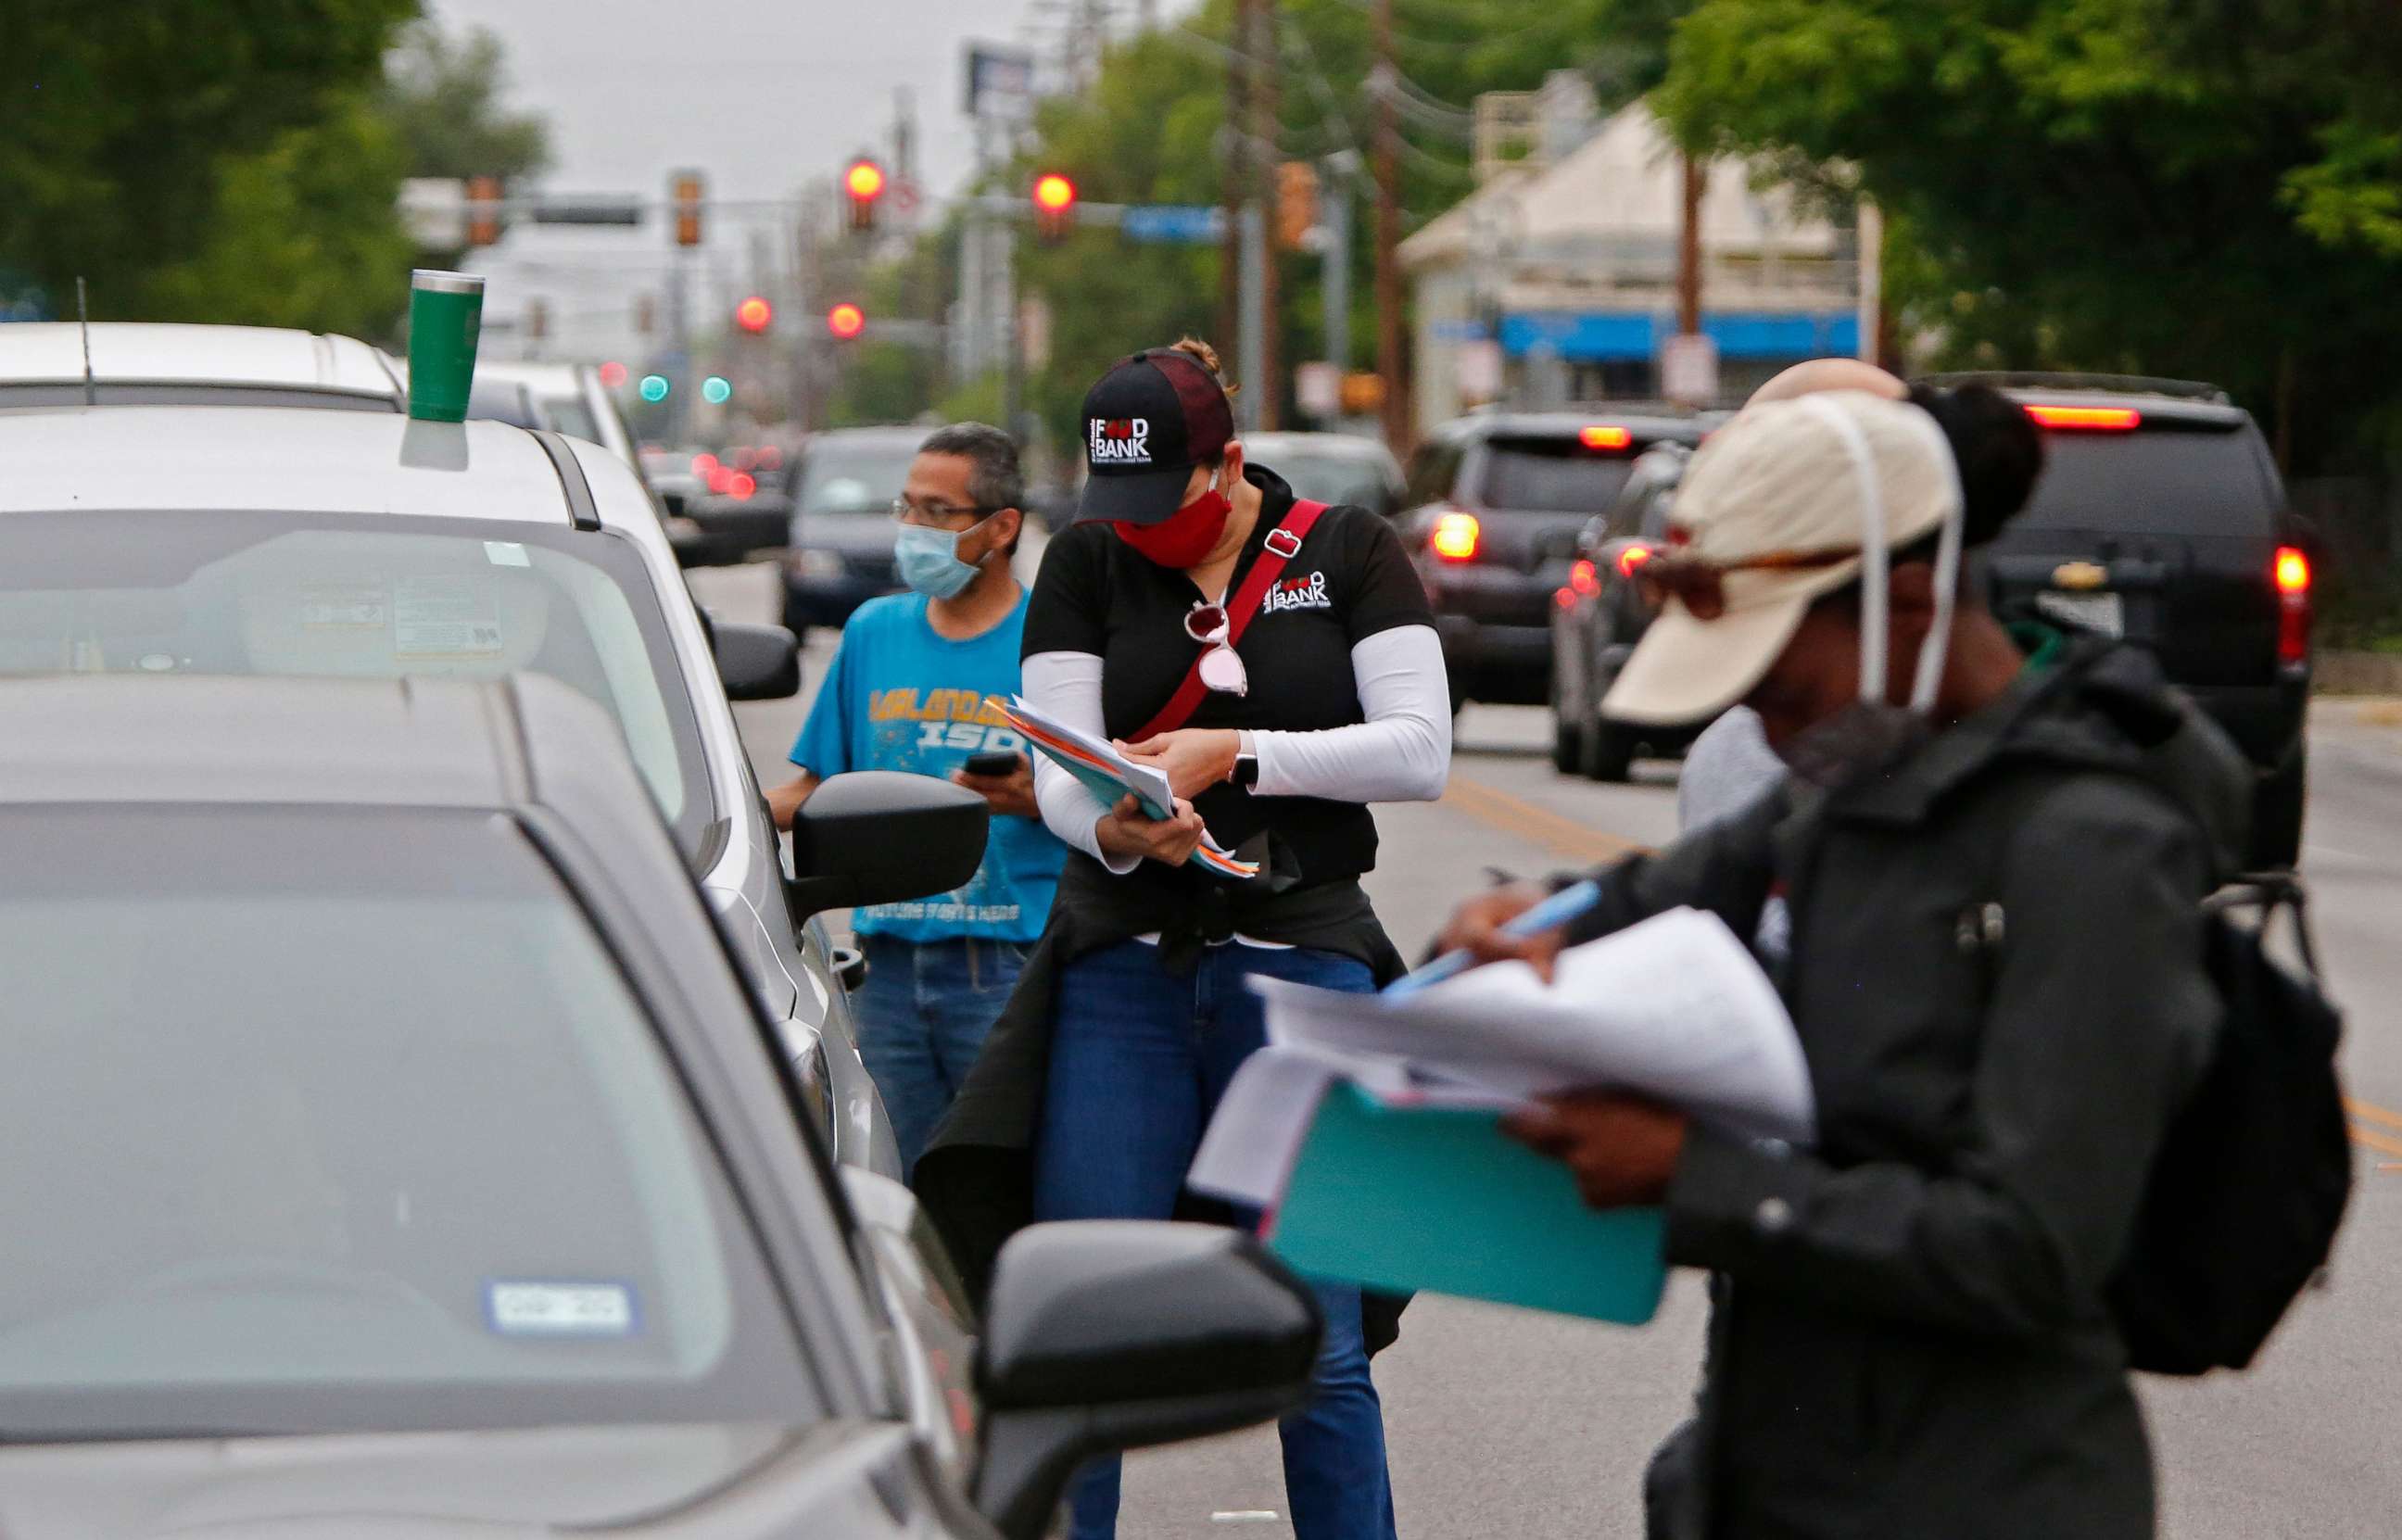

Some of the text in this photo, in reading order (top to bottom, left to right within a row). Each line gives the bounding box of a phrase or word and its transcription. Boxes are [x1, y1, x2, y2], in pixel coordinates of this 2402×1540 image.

[1095, 437, 1150, 458] BANK
[1272, 584, 1329, 607] BANK
[917, 721, 1028, 753] ISD
